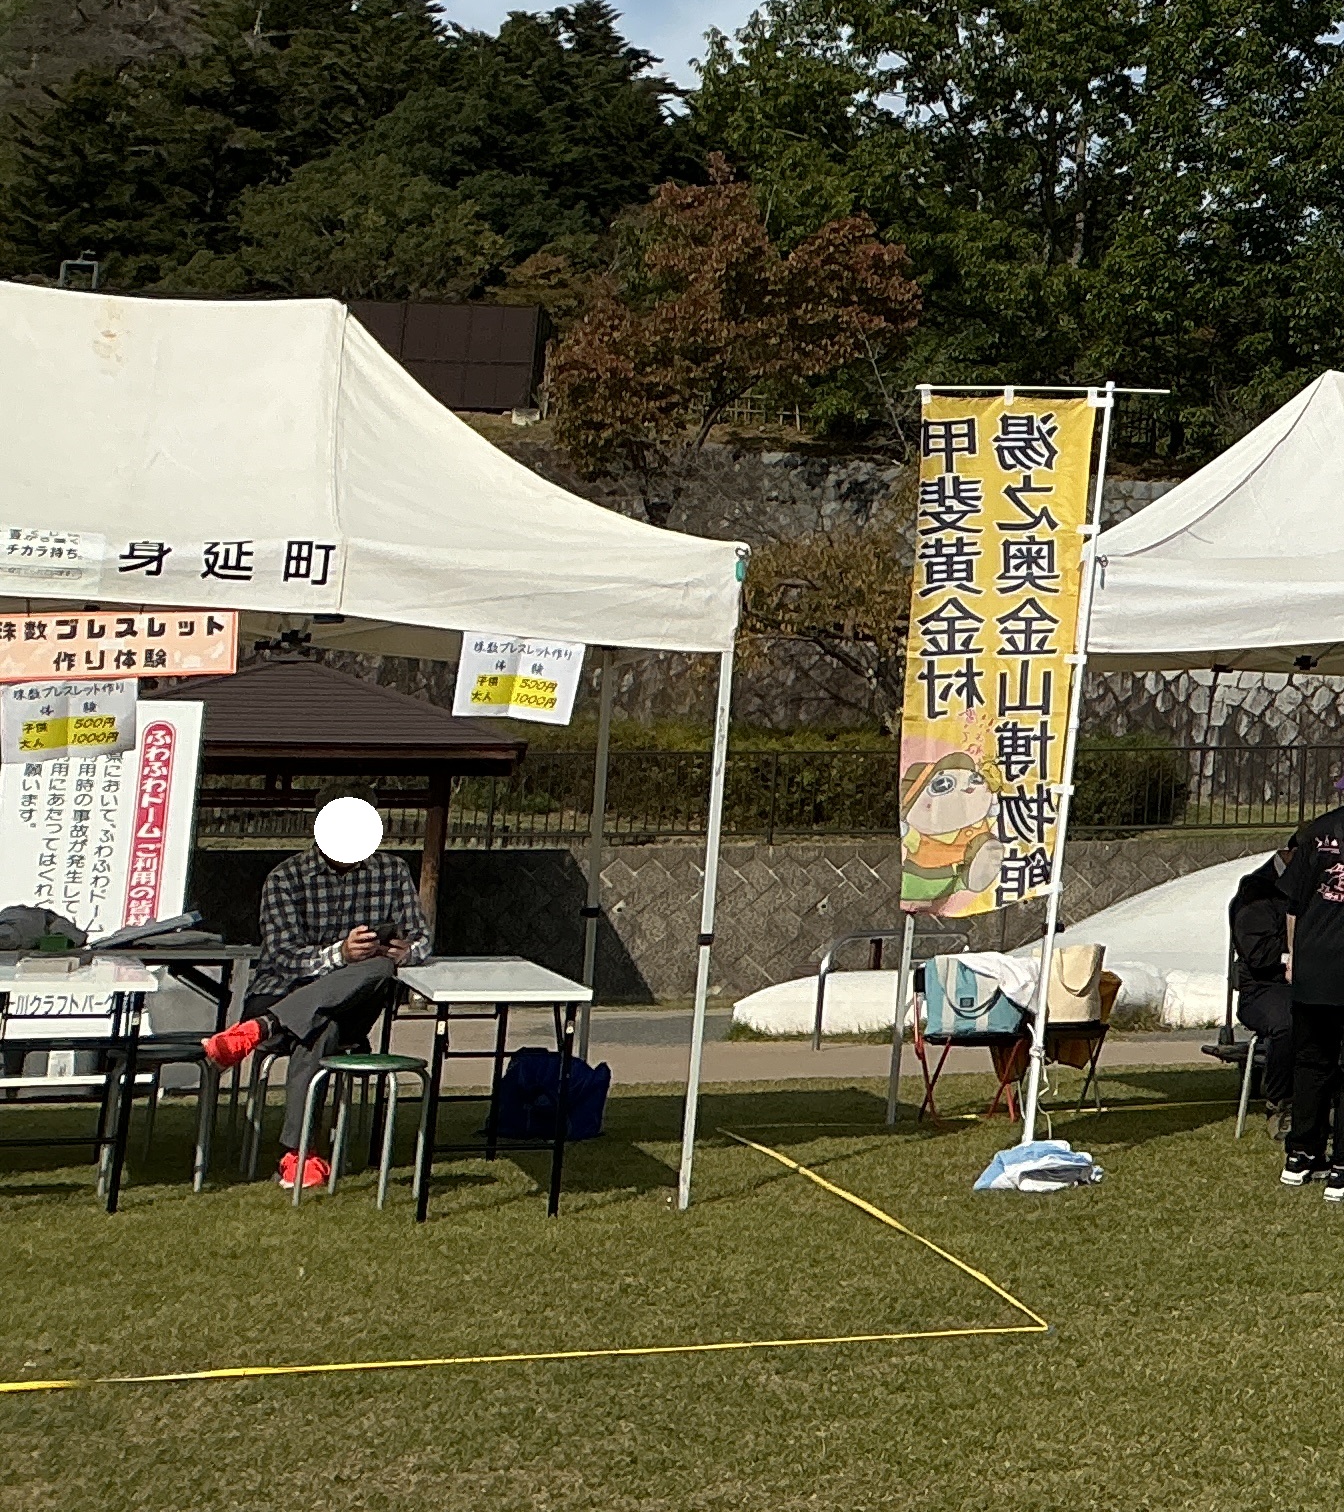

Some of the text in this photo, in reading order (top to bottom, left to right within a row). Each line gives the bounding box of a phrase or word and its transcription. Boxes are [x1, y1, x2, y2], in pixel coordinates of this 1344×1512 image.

[118, 540, 337, 585] 身延町
[53, 648, 167, 672] 作り体験
[519, 678, 558, 693] 500円
[470, 691, 557, 709] 大人 1000円
[74, 717, 116, 730] 500円
[19, 731, 119, 750] 大人 1000円
[62, 756, 97, 926] 用時の事故が発生して
